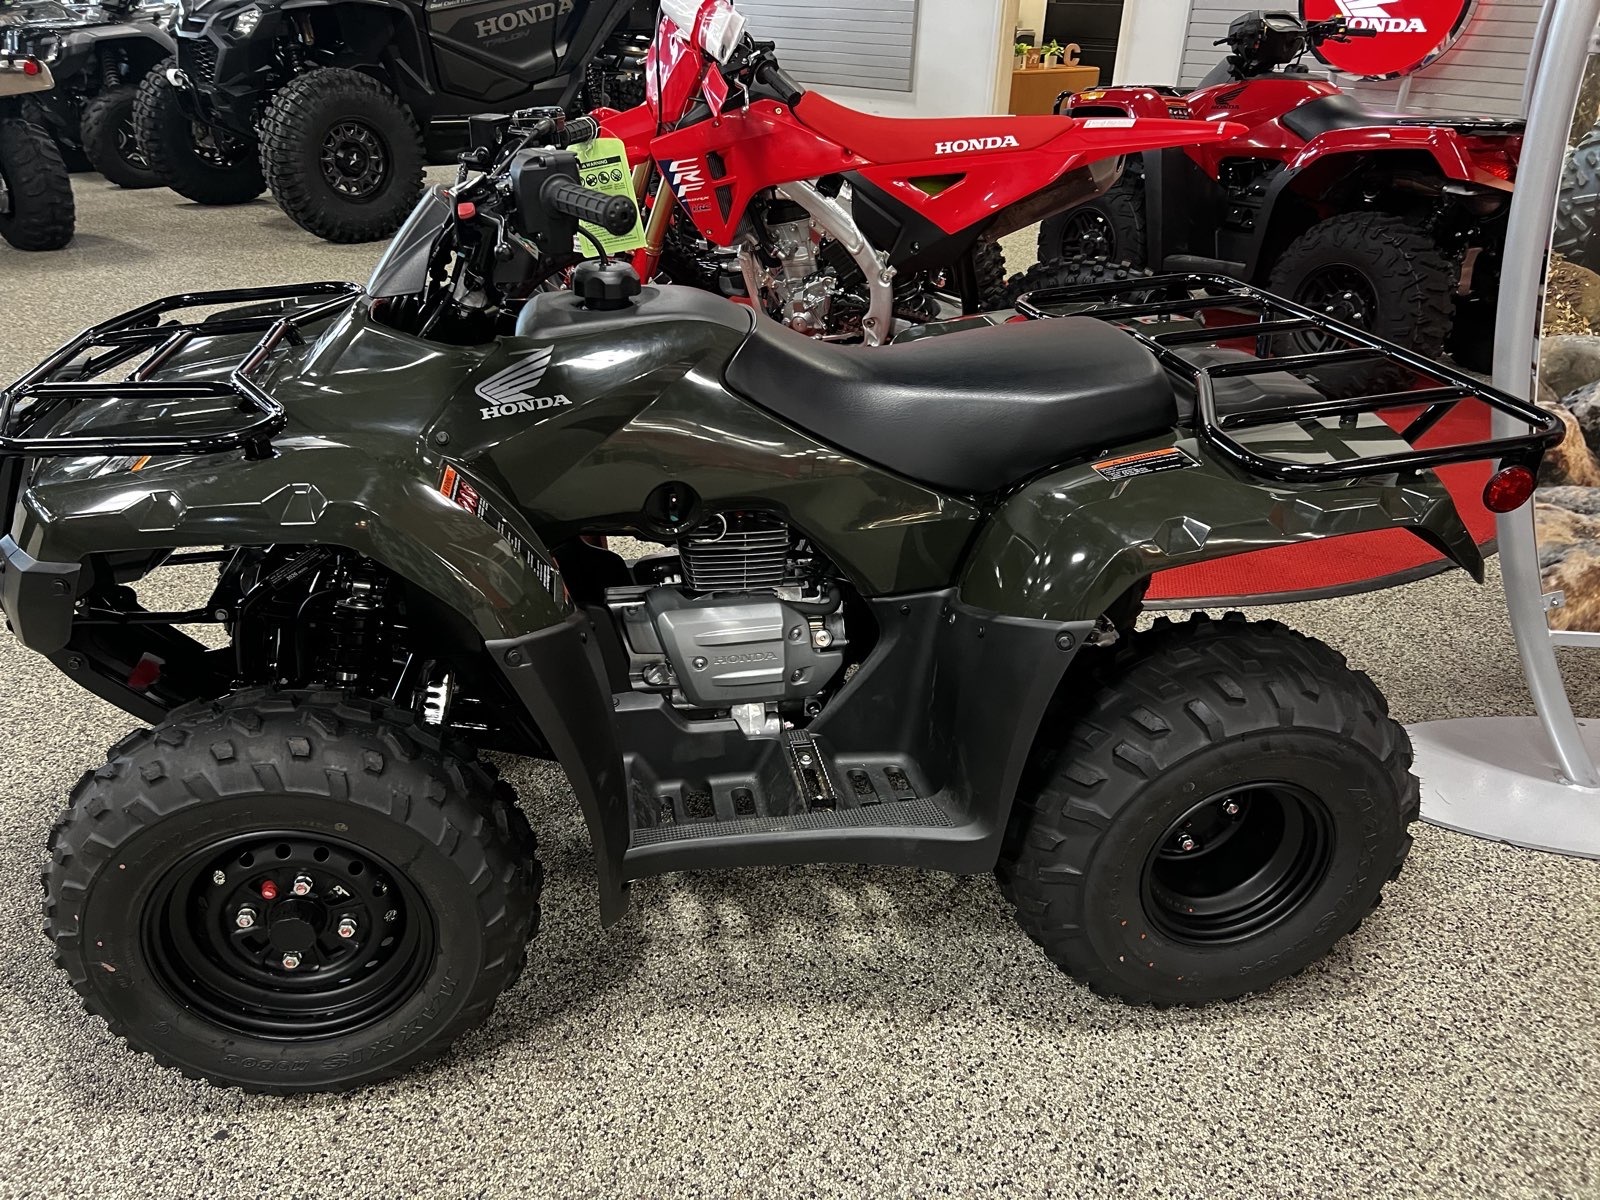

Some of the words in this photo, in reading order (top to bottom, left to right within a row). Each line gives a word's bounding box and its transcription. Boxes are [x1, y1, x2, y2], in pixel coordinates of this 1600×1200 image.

[474, 0, 574, 38] HONDA
[934, 135, 1019, 155] HONDA
[585, 159, 608, 168] WARNING
[669, 157, 706, 198] CRF
[480, 394, 573, 420] HONDA
[713, 651, 779, 665] HONDA
[320, 967, 460, 1070] MAXXIS
